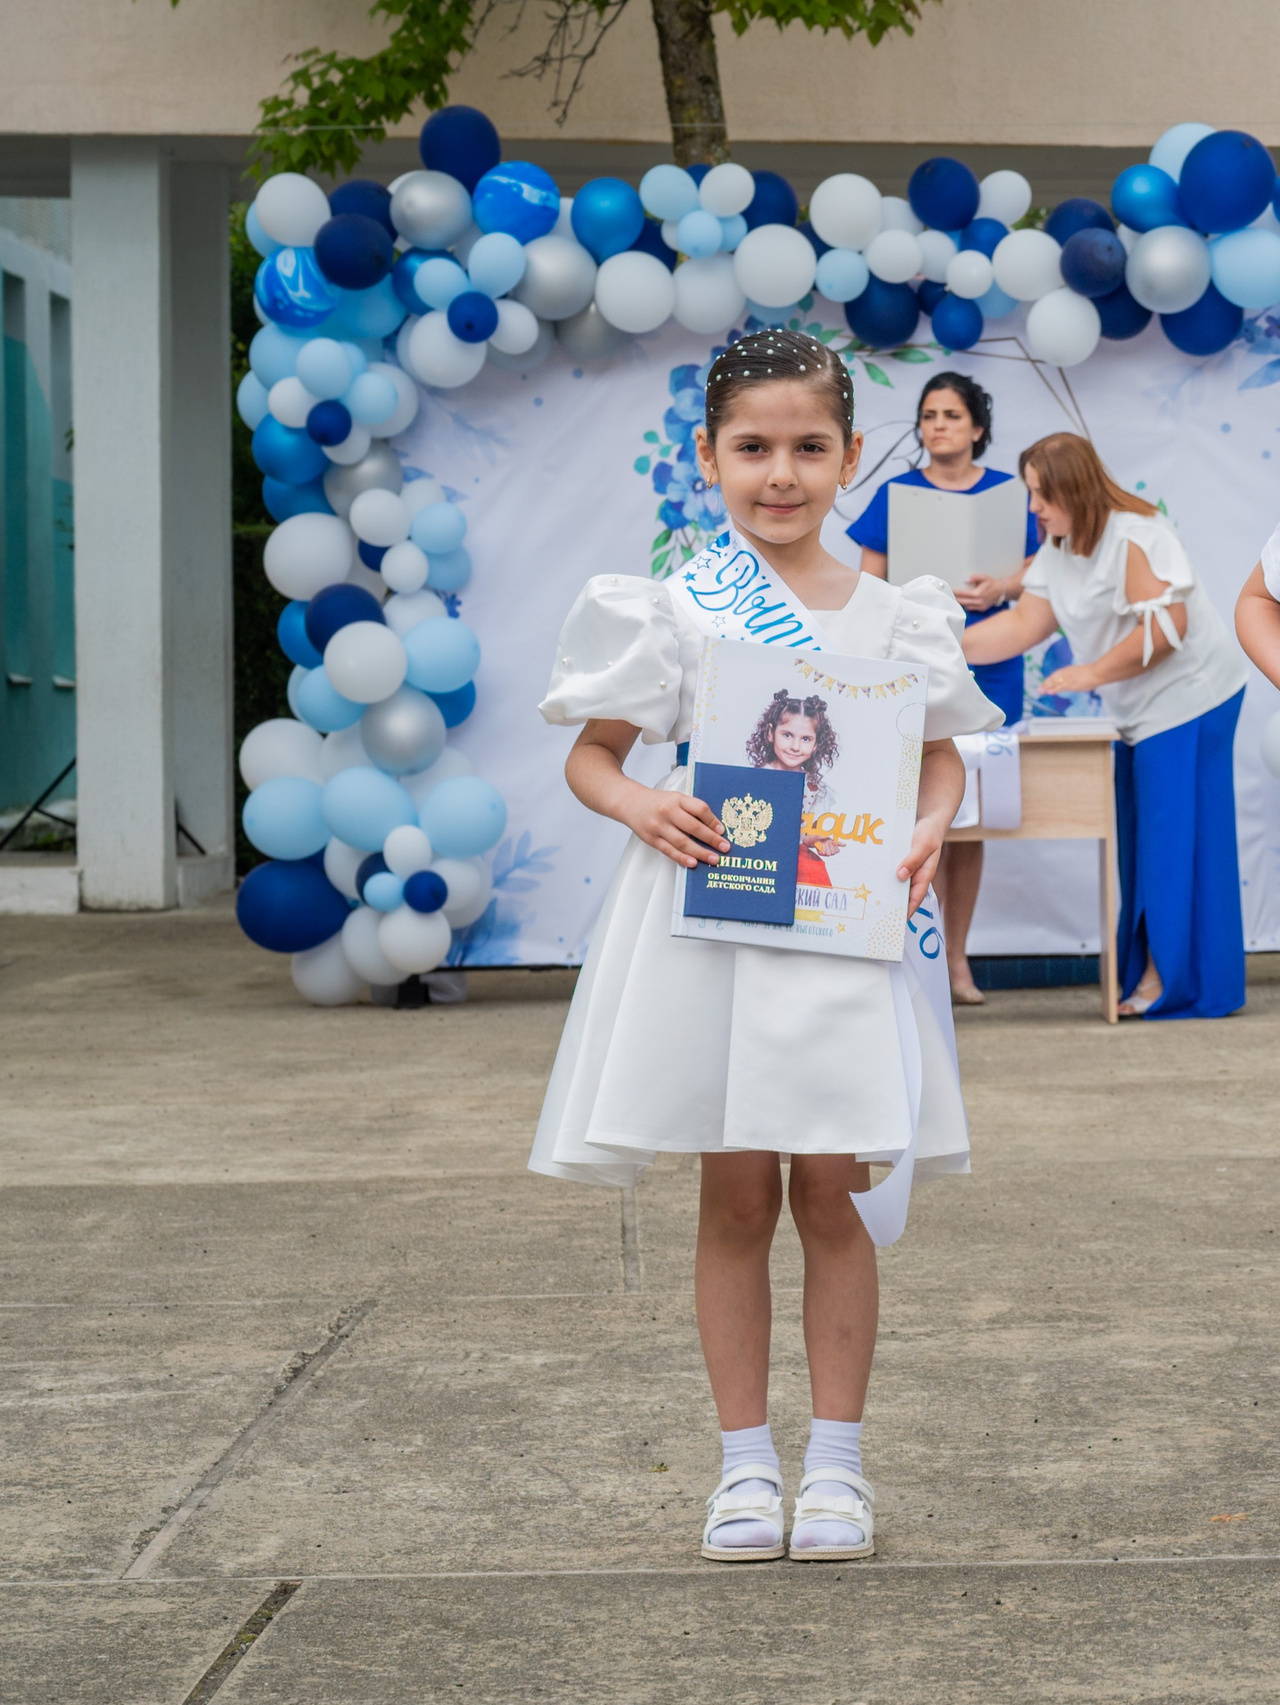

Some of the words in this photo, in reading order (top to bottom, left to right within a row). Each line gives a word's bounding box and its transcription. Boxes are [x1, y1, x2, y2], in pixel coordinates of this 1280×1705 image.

[709, 856, 777, 872] ИПЛОМ
[707, 872, 720, 881] ОБ
[721, 873, 775, 886] ОКОНЧАНИИ
[706, 880, 752, 892] ДЕТСКОГО
[753, 884, 776, 894] САДА
[795, 887, 821, 908] КИЙ
[825, 891, 847, 911] САД
[796, 924, 833, 938] ВЫГОТСКОГО
